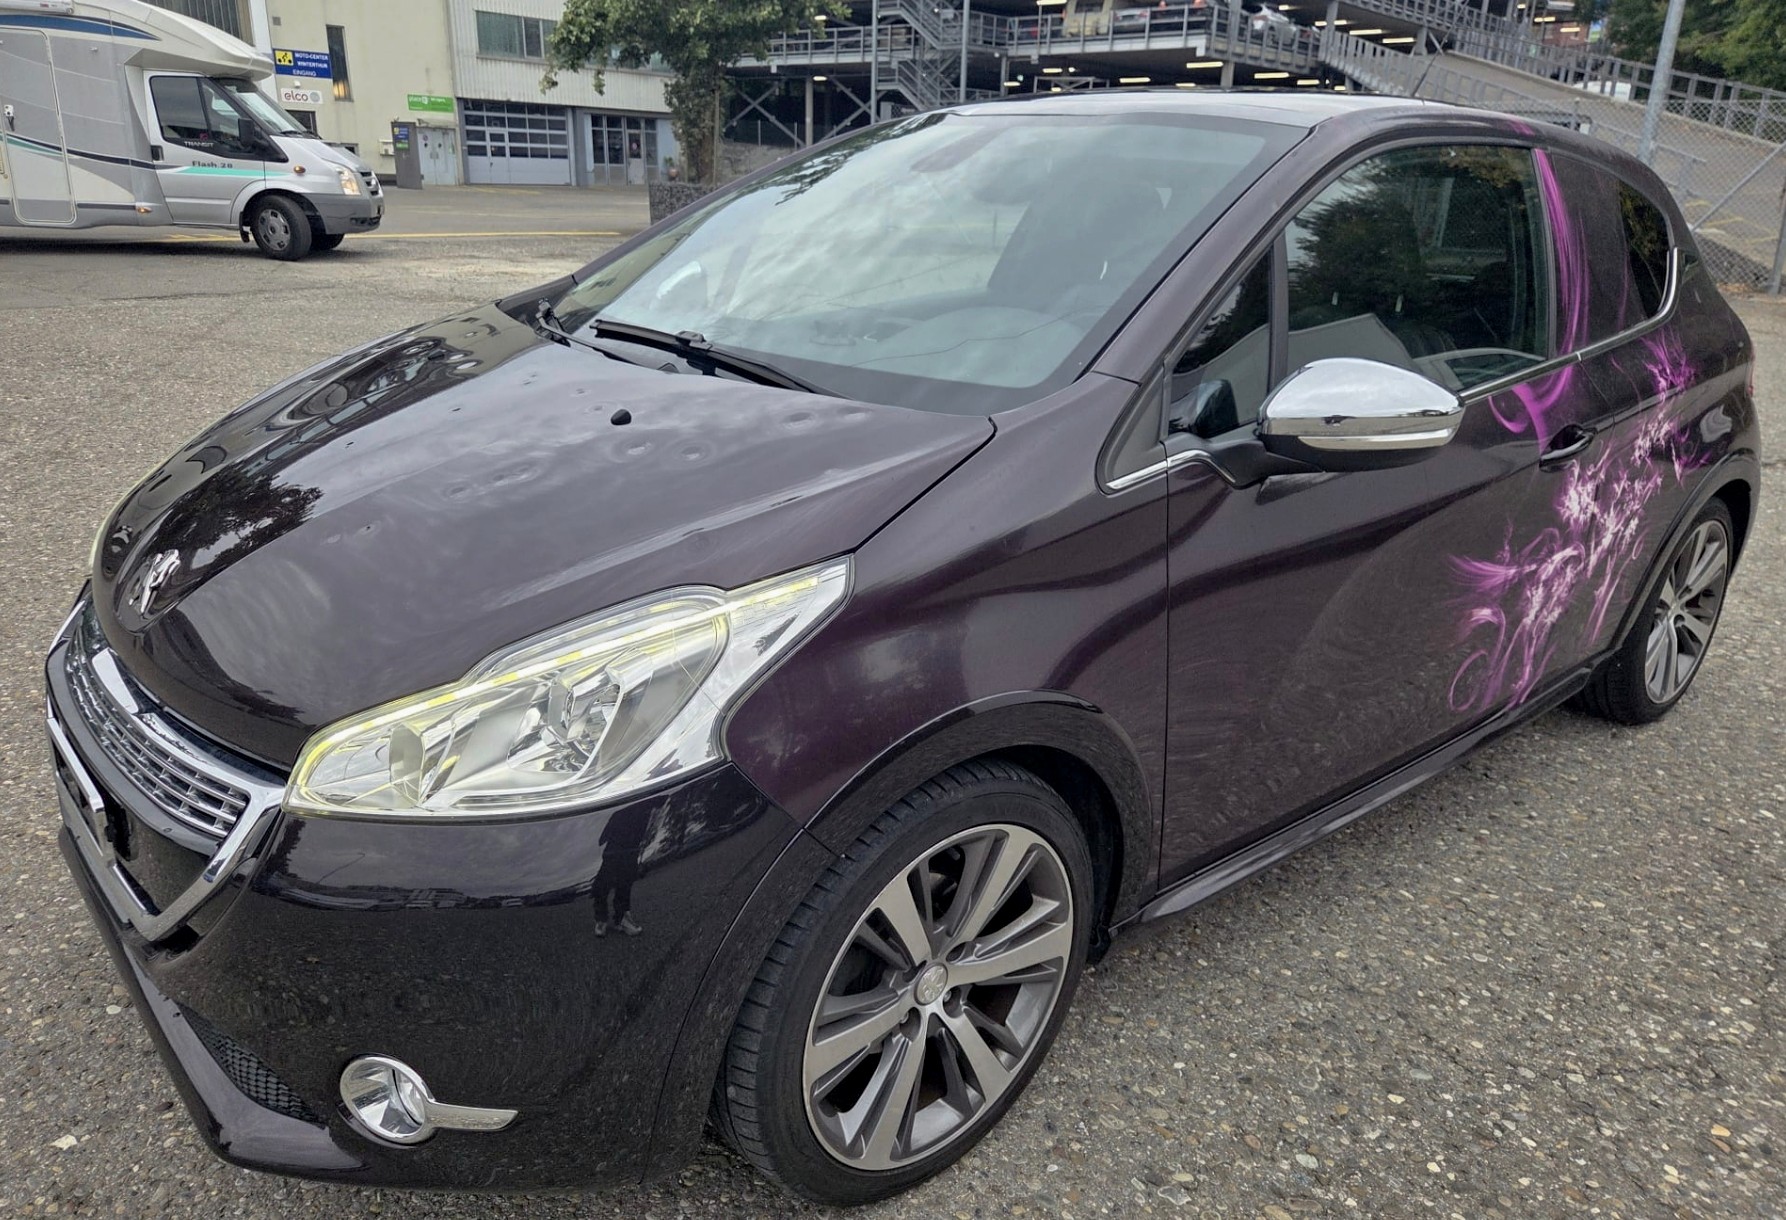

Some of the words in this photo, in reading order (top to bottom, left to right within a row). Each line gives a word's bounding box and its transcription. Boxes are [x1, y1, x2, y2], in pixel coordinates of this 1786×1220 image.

[294, 52, 329, 60] MOTO-CENTER
[297, 61, 328, 69] WINTERTHUR
[292, 69, 317, 77] EINGANG
[284, 90, 309, 102] elco
[184, 141, 214, 149] TRANSIT
[192, 160, 217, 168] Flash
